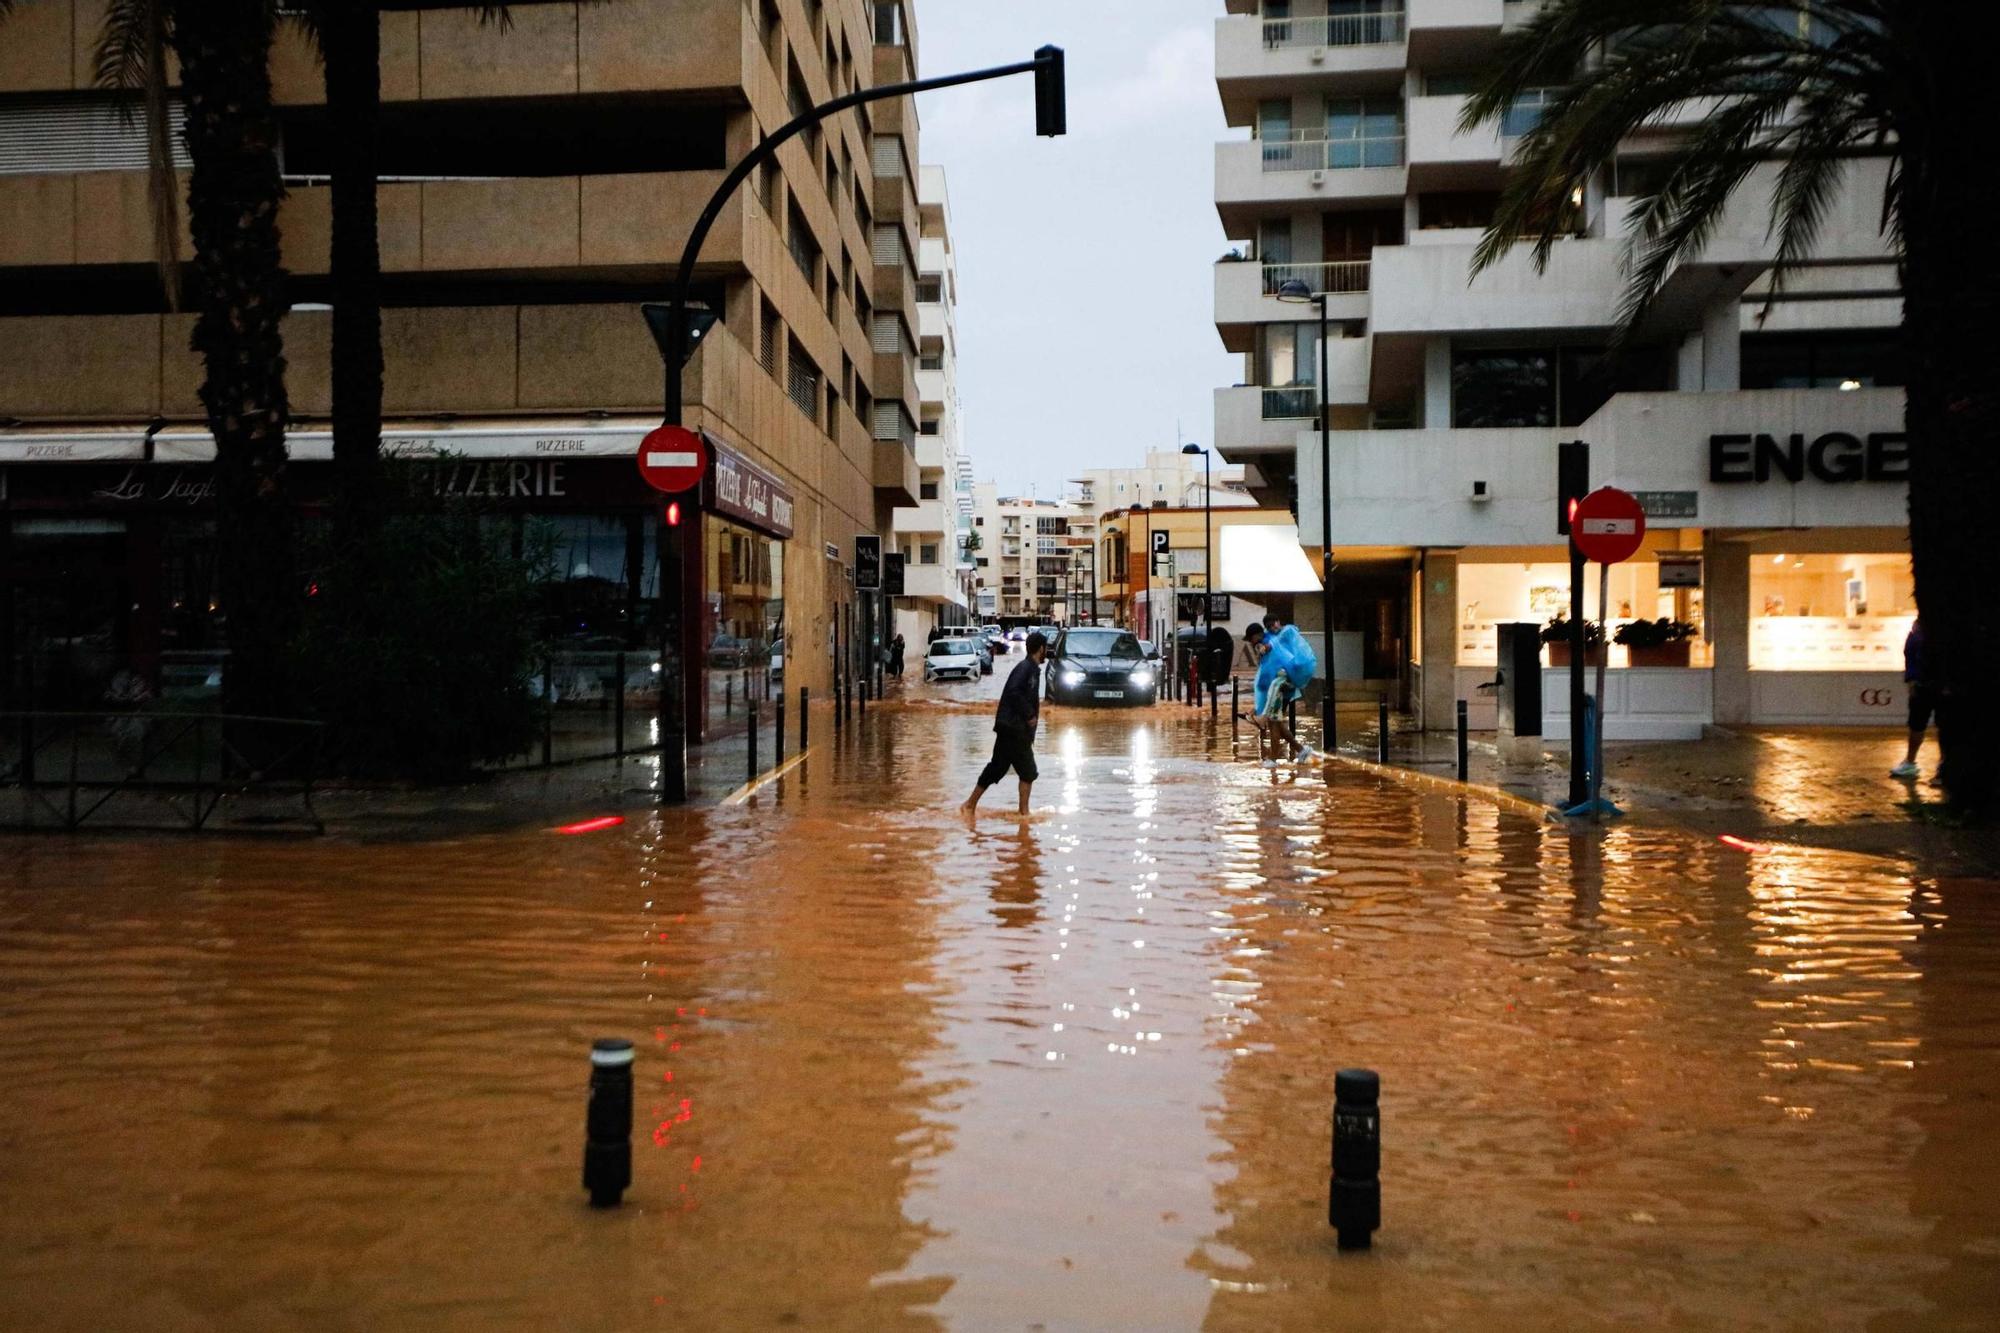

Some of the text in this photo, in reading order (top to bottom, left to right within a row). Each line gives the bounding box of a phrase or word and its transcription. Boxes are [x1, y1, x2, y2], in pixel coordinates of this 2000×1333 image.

[536, 440, 585, 451] PIZZERIE
[1710, 432, 1909, 482] ENGE
[93, 463, 144, 499] La
[1154, 533, 1167, 551] P
